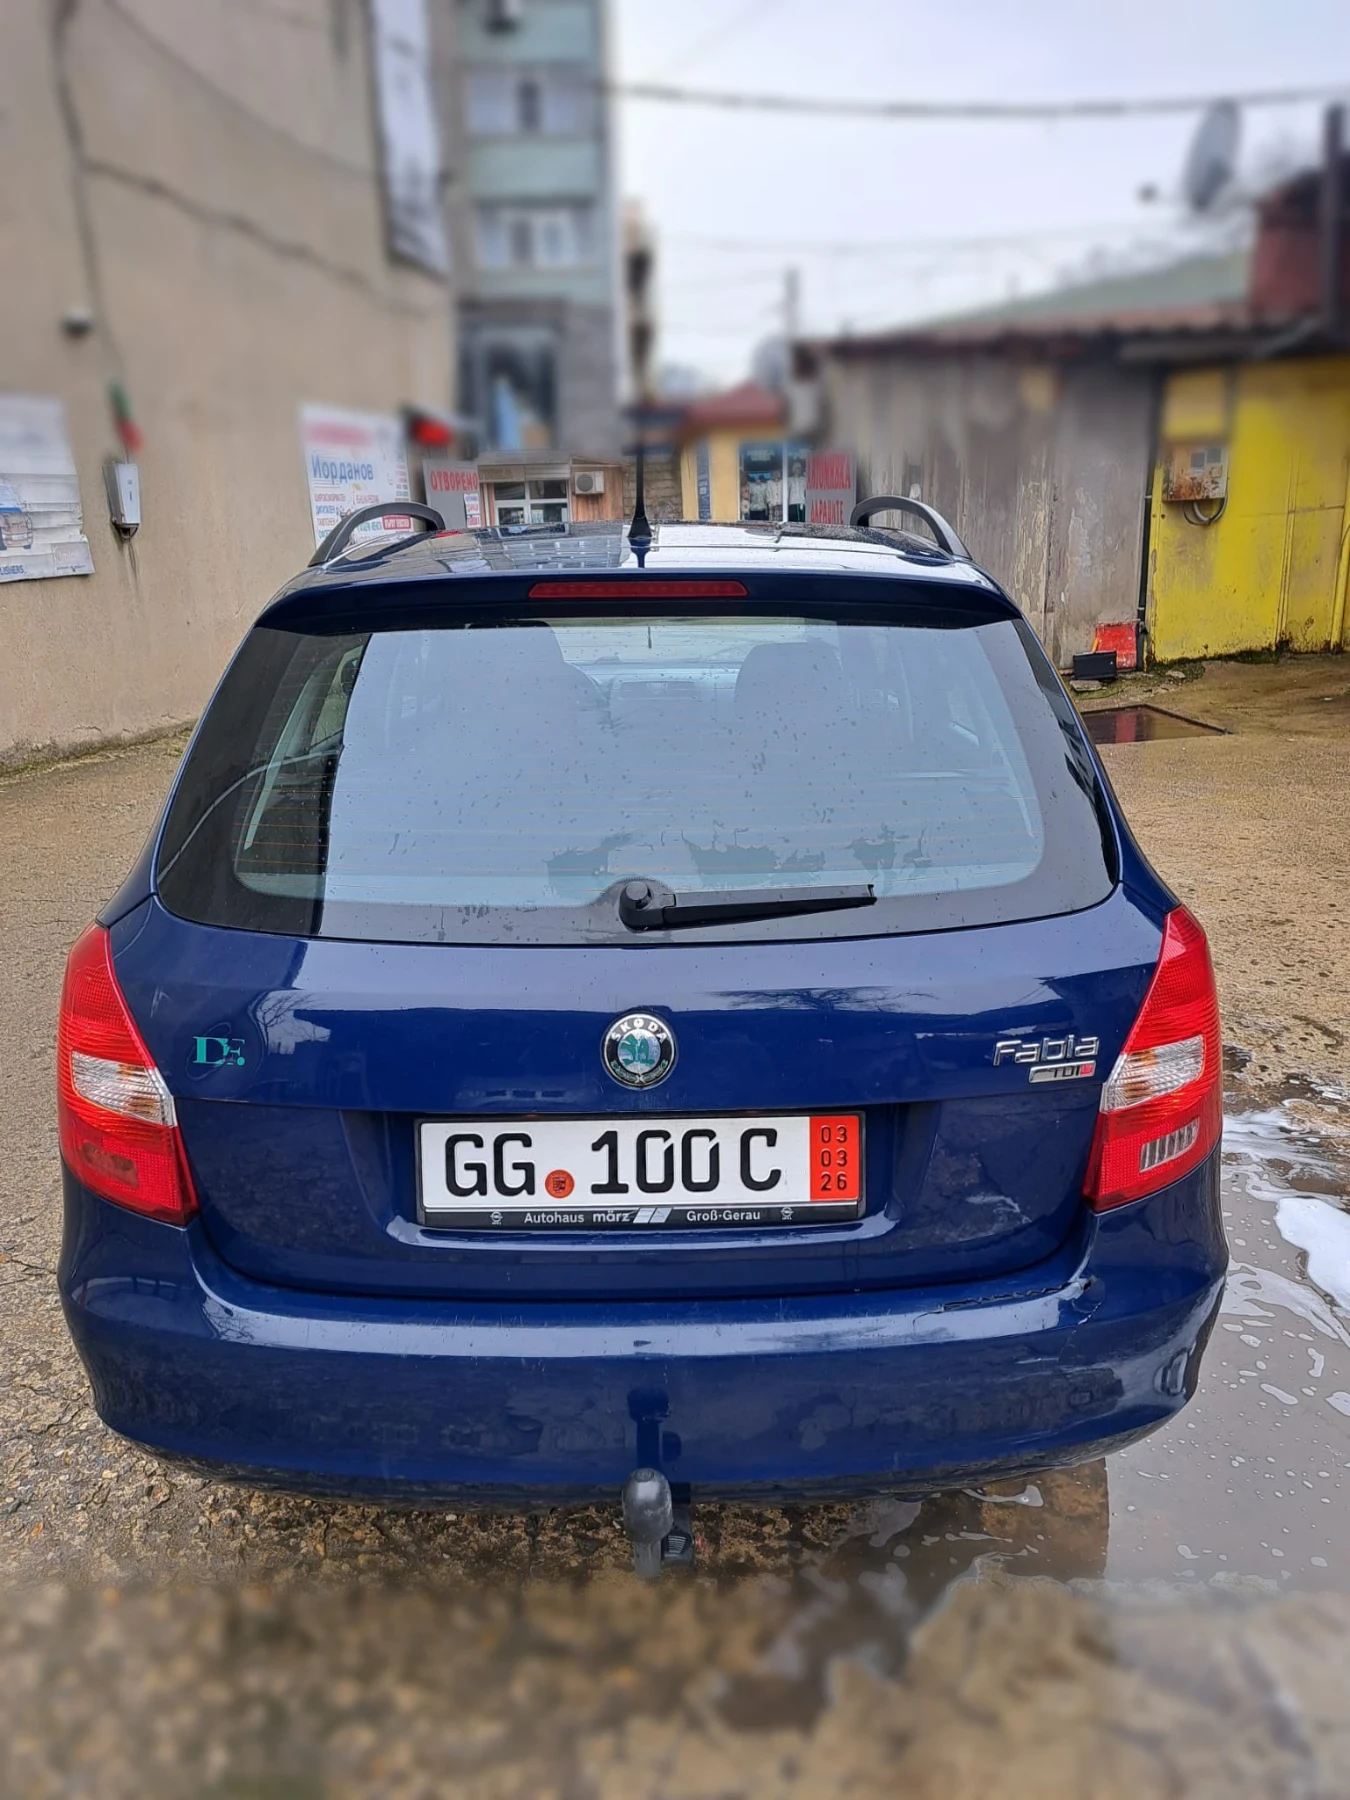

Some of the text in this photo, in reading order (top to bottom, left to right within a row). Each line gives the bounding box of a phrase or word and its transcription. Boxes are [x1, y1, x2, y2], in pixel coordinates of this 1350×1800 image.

[430, 469, 479, 492] ОТВОРЕНО
[993, 1034, 1100, 1066] Fabia
[820, 1125, 849, 1144] 03
[445, 1128, 782, 1197] GG 100 C
[820, 1149, 849, 1168] 03
[820, 1172, 849, 1192] 26
[523, 1209, 761, 1224] Autohaus märz Groß-Gerau
